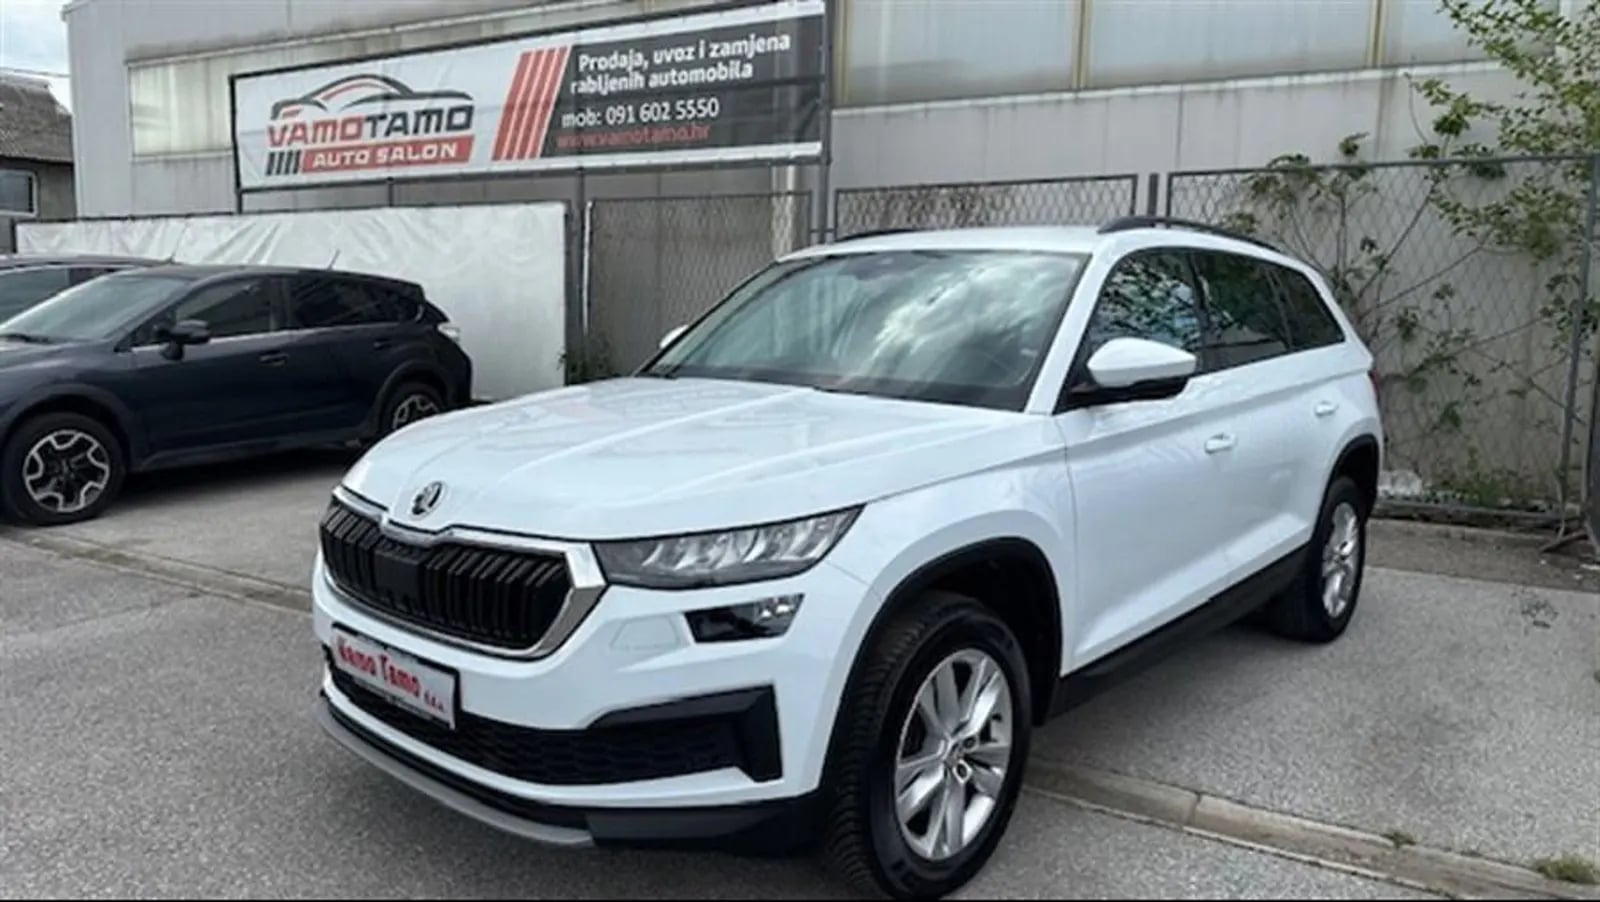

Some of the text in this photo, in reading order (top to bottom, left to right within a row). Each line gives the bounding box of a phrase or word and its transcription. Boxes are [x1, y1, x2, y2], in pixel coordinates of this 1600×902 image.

[578, 33, 791, 72] Prodaja, uvoz i zamjena
[570, 60, 752, 96] rabljenih automobila
[561, 97, 719, 127] mob: 091 602 5550
[312, 143, 457, 168] AUTO SALON
[380, 654, 419, 697] Tamo
